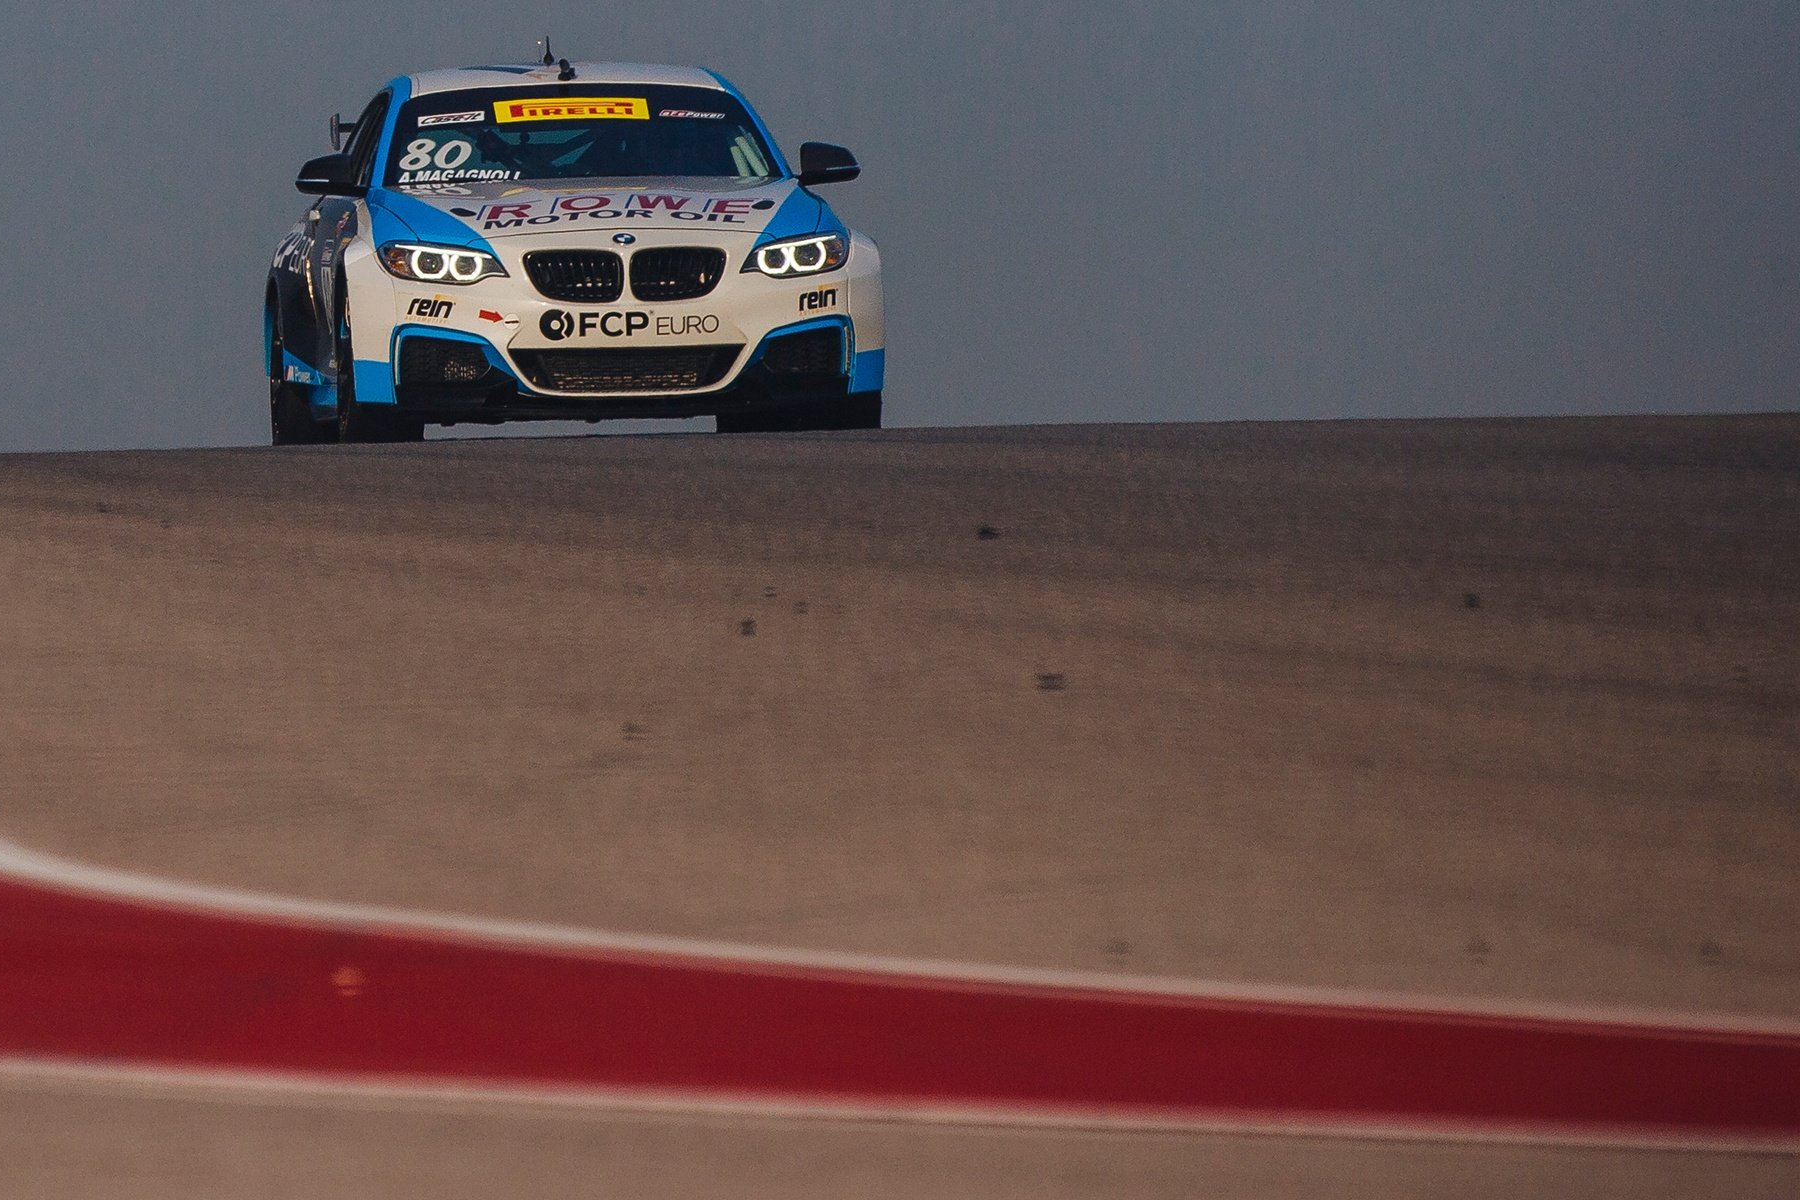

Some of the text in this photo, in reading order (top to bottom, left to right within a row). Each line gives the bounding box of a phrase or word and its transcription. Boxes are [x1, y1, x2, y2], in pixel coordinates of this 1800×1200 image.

[509, 103, 634, 118] PIRELLI
[398, 138, 473, 171] 80
[483, 209, 747, 230] MOTOR OIL
[486, 195, 756, 220] ROWE
[406, 296, 455, 319] rein
[798, 286, 838, 312] rein
[579, 311, 720, 338] FCP EURO
